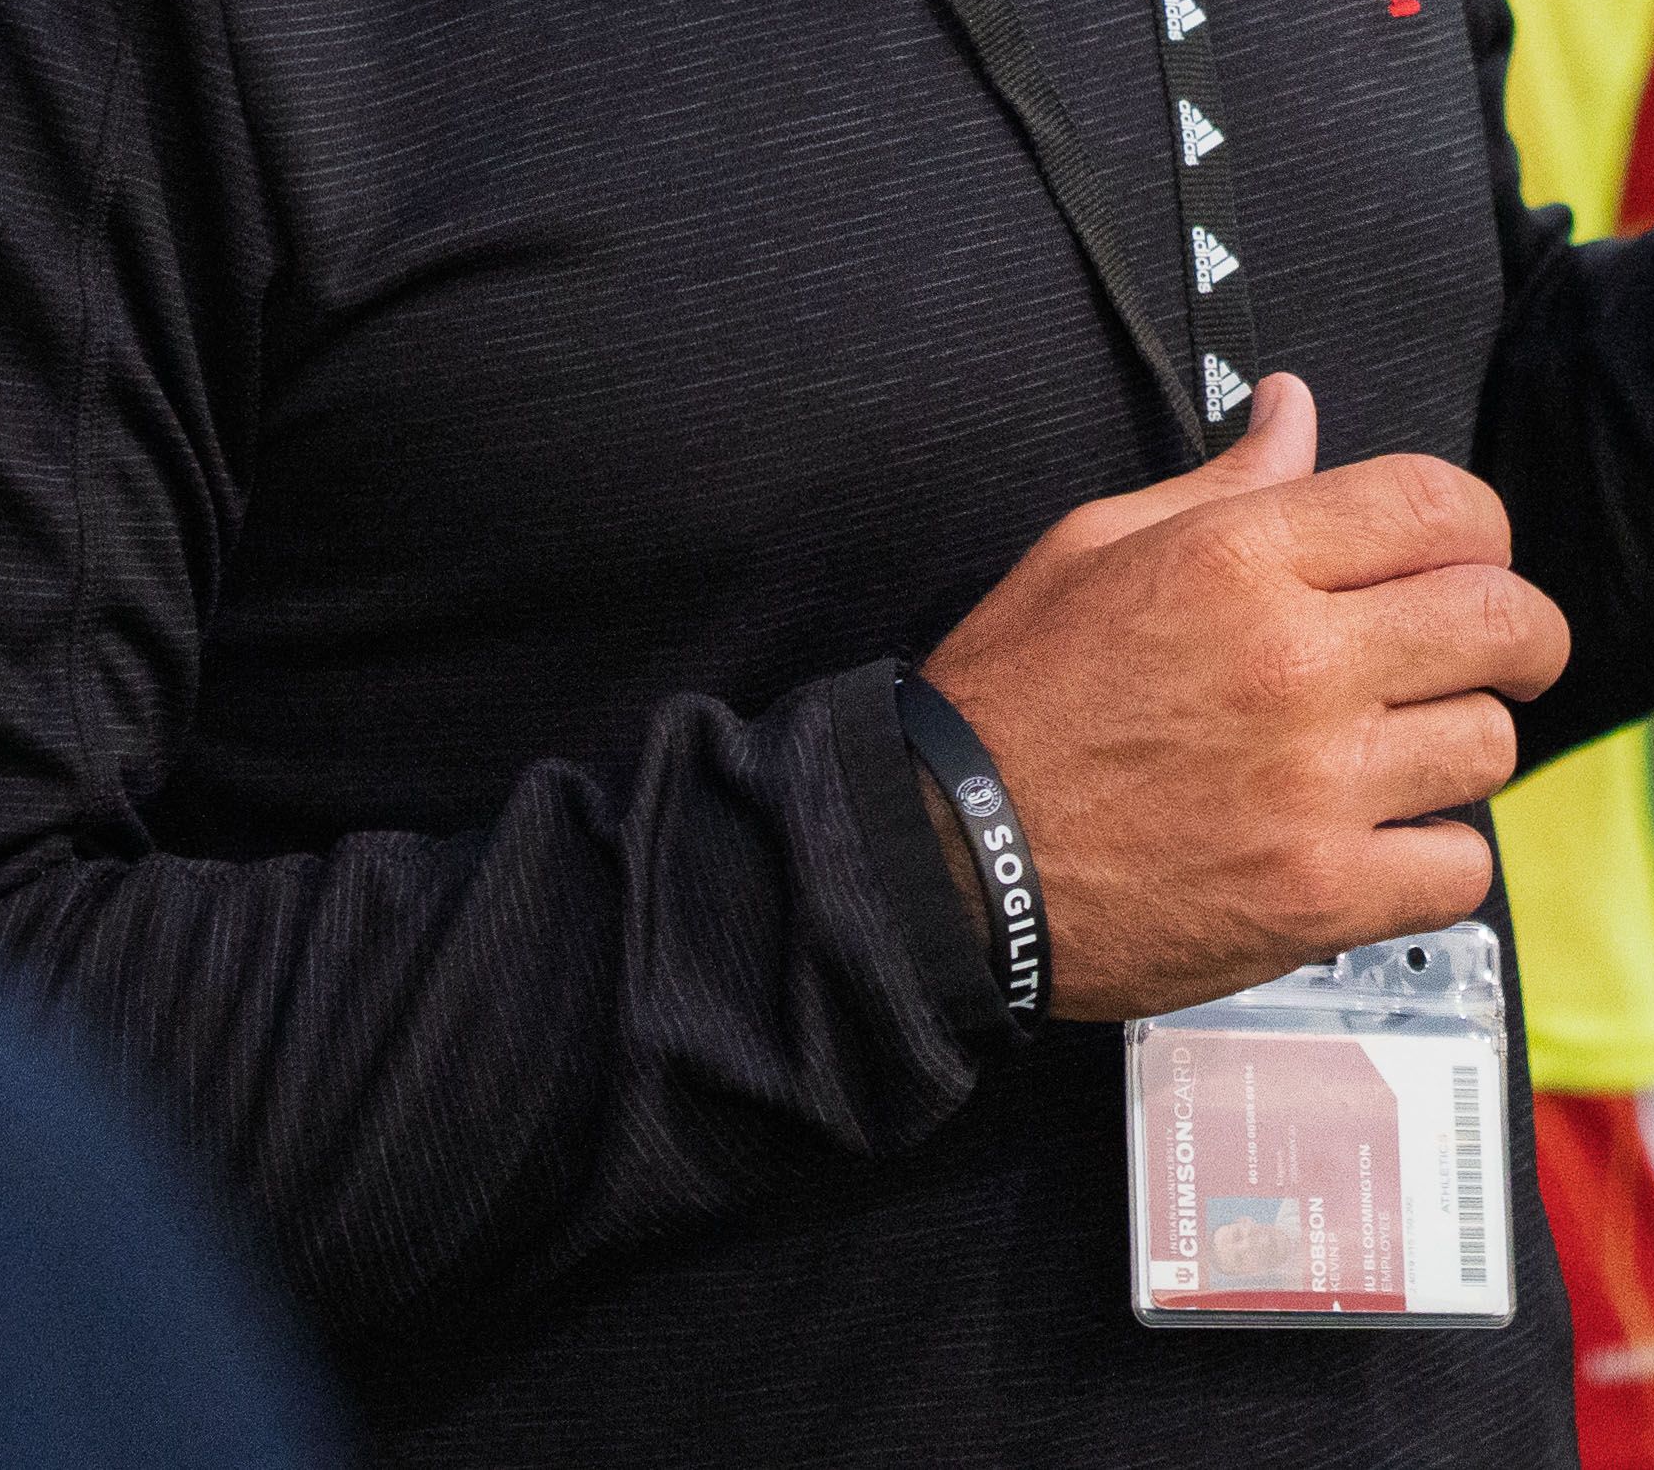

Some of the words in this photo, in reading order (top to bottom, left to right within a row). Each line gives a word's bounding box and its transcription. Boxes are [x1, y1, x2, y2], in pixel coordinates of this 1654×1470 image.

[1178, 99, 1200, 166] adidas
[1192, 226, 1213, 294] adidas
[1204, 353, 1224, 423] adidas
[983, 824, 1039, 1009] SOGILITY
[1166, 1128, 1176, 1201] UNIVERSITY
[1172, 1047, 1198, 1257] CRIMSONCARD
[1168, 1203, 1177, 1254] INDIANA
[1328, 1232, 1338, 1243] P
[1358, 1143, 1376, 1270] BLOOMINGTON
[1308, 1197, 1327, 1292] ROBSON
[1328, 1246, 1340, 1291] KEVIN
[1378, 1211, 1392, 1292] EMPLOYEE
[1364, 1275, 1377, 1292] IU
